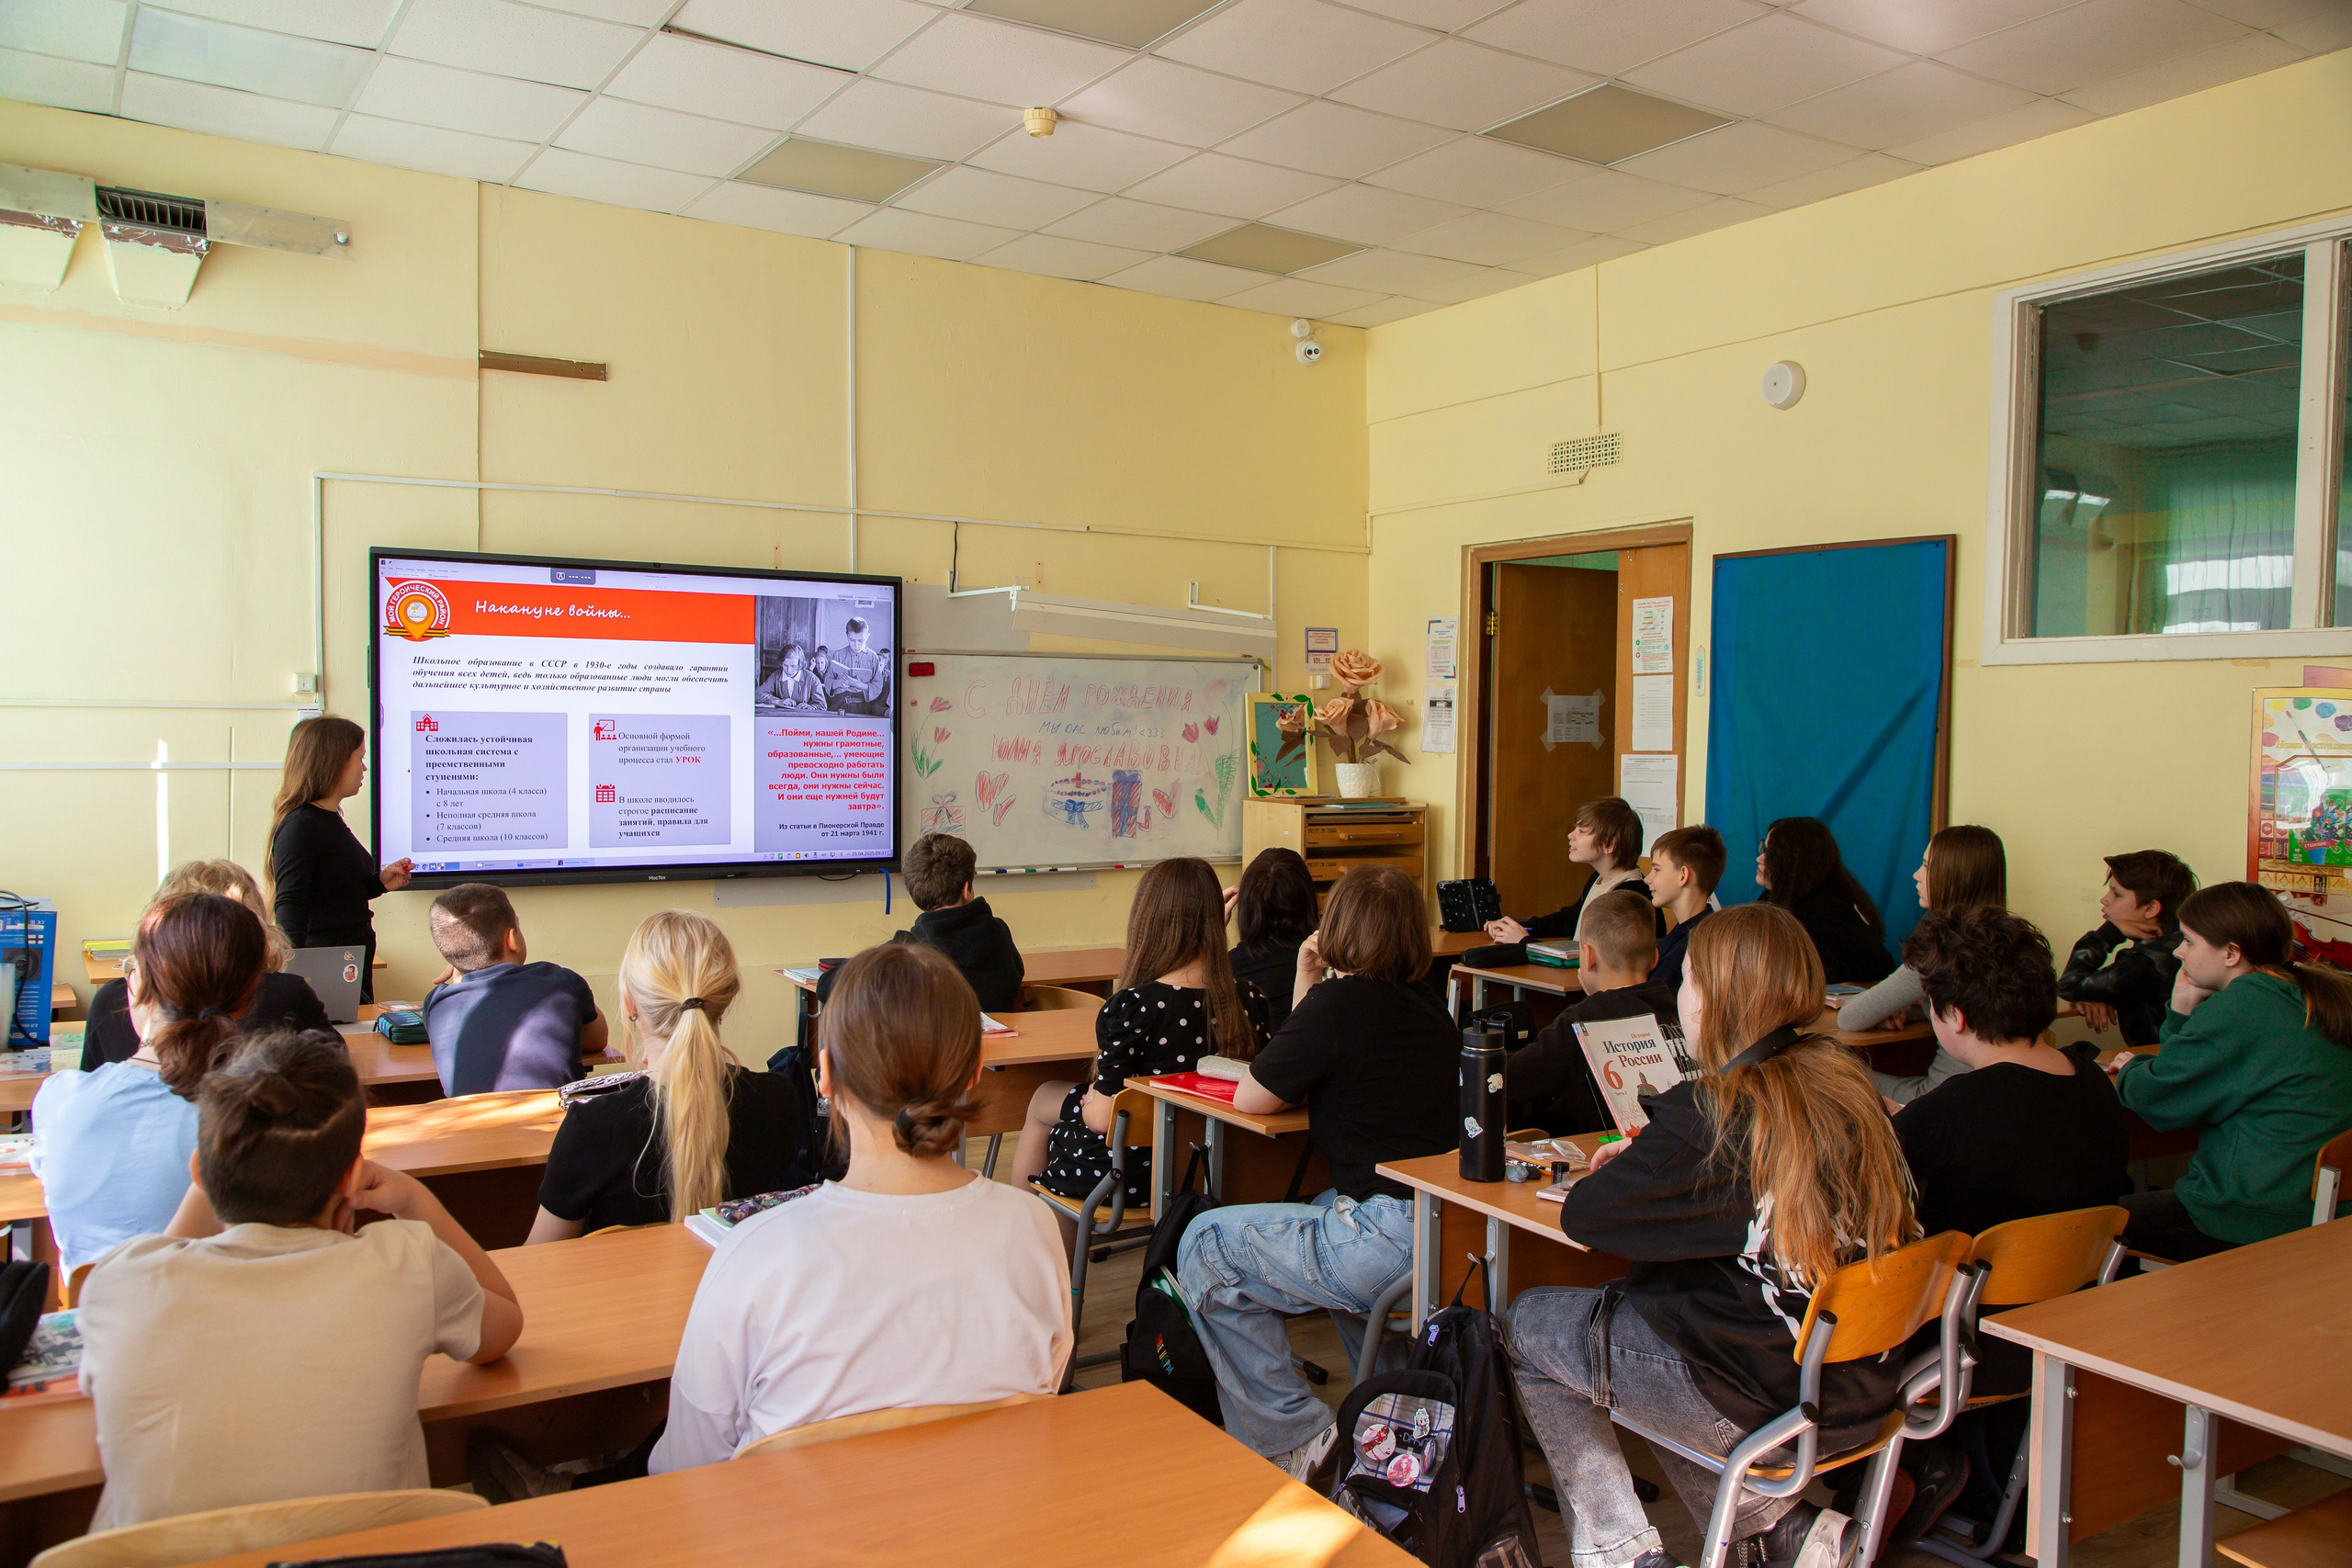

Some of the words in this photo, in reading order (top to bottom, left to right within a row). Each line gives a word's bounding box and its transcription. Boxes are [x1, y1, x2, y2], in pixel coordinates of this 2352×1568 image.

[390, 584, 440, 605] ГЕРОИЧЕСКИЙ
[387, 605, 396, 623] МОЙ
[437, 600, 447, 625] РАЙОН
[475, 600, 564, 619] Накануне
[569, 603, 631, 619] войны...
[413, 656, 461, 666] Школьное
[468, 658, 522, 667] образование
[541, 660, 567, 668] СССР
[585, 660, 612, 669] 1930-е
[413, 670, 455, 678] обучения
[480, 670, 510, 679] детей,
[570, 672, 628, 682] образованные
[682, 675, 729, 683] обеспечить
[413, 681, 468, 689] дальнейшее
[469, 682, 521, 691] культурное
[531, 683, 596, 692] хозяйственное
[597, 685, 637, 693] развитие
[639, 686, 671, 694] страны
[964, 679, 987, 719] С
[1006, 676, 1071, 715] ДНЁМ
[1082, 683, 1193, 712] РОЖДЕНИЯ
[767, 728, 813, 738] «...Пойми,
[1038, 722, 1062, 734] МЫ
[1064, 723, 1086, 734] ВАС
[425, 735, 478, 743] Сложилась
[481, 736, 533, 744] устойчивая
[660, 733, 690, 741] формой
[670, 744, 706, 753] учебного
[835, 741, 885, 749] грамотные,
[767, 750, 842, 759] образованные,...
[991, 734, 1042, 767] ЮЛИЯ
[618, 756, 655, 765] процесса
[846, 761, 885, 770] работать
[425, 773, 479, 782] ступенями:
[518, 787, 547, 795] класса)
[825, 792, 858, 801] нужней
[860, 792, 885, 801] будут
[651, 807, 698, 816] расписание
[847, 803, 885, 811] завтра».
[447, 823, 482, 831] классов)
[618, 818, 656, 827] занятий,
[657, 818, 692, 827] правила
[436, 835, 471, 843] Средняя
[500, 833, 513, 841] (10
[618, 829, 661, 839] учащихся
[1603, 1039, 1657, 1053] История
[1617, 1054, 1663, 1068] России
[1603, 1060, 1623, 1090] 6
